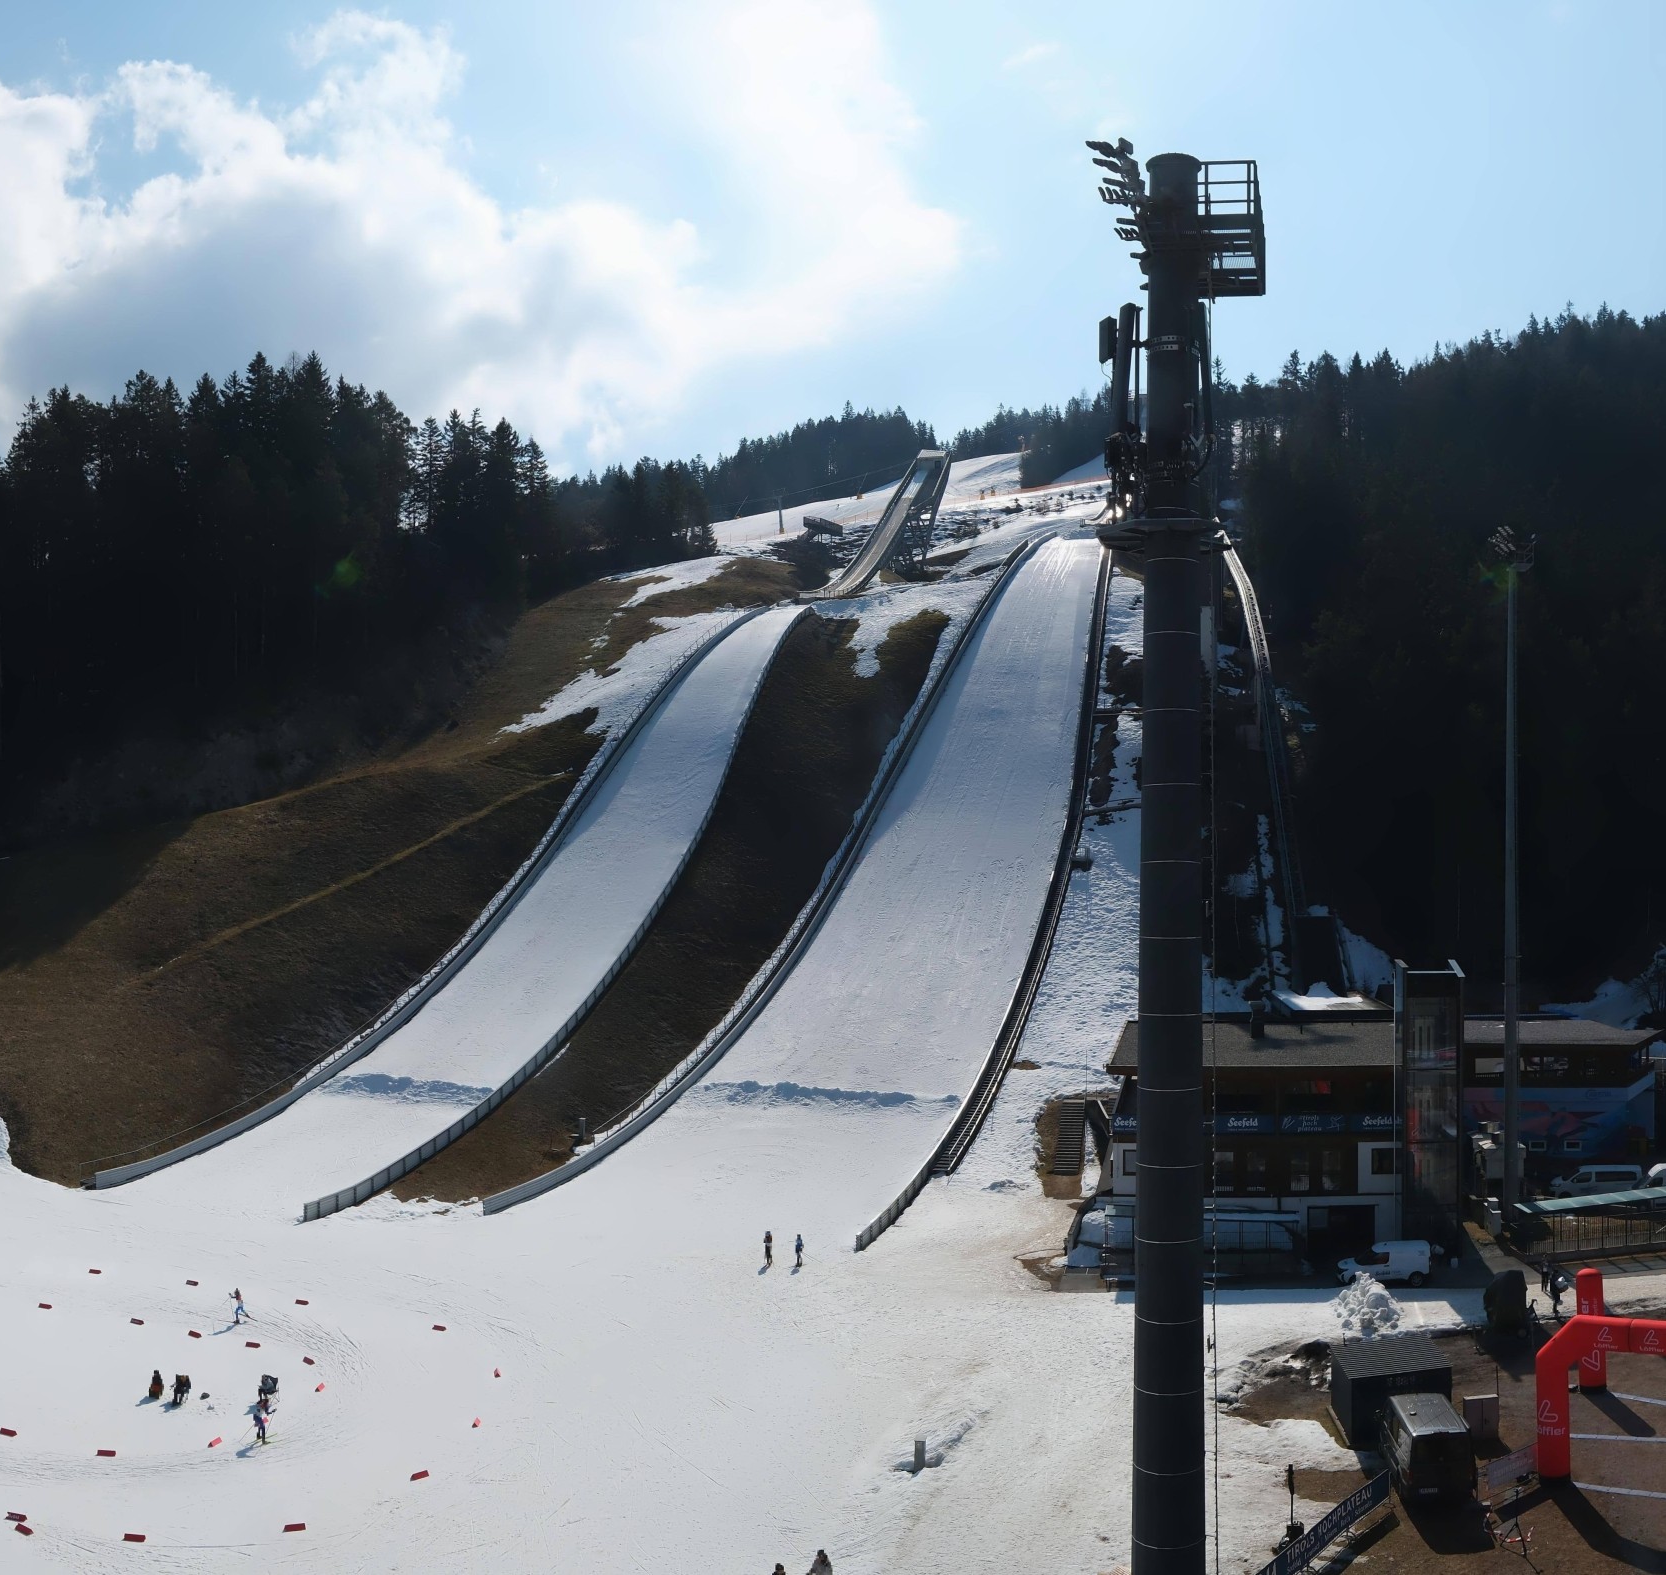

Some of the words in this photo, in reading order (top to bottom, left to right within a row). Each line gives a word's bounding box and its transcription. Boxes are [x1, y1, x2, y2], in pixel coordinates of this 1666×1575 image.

[1113, 1116, 1137, 1127] Seefe
[1286, 1531, 1315, 1564] TIROLS
[1317, 1485, 1373, 1538] HOCHPLATEAU
